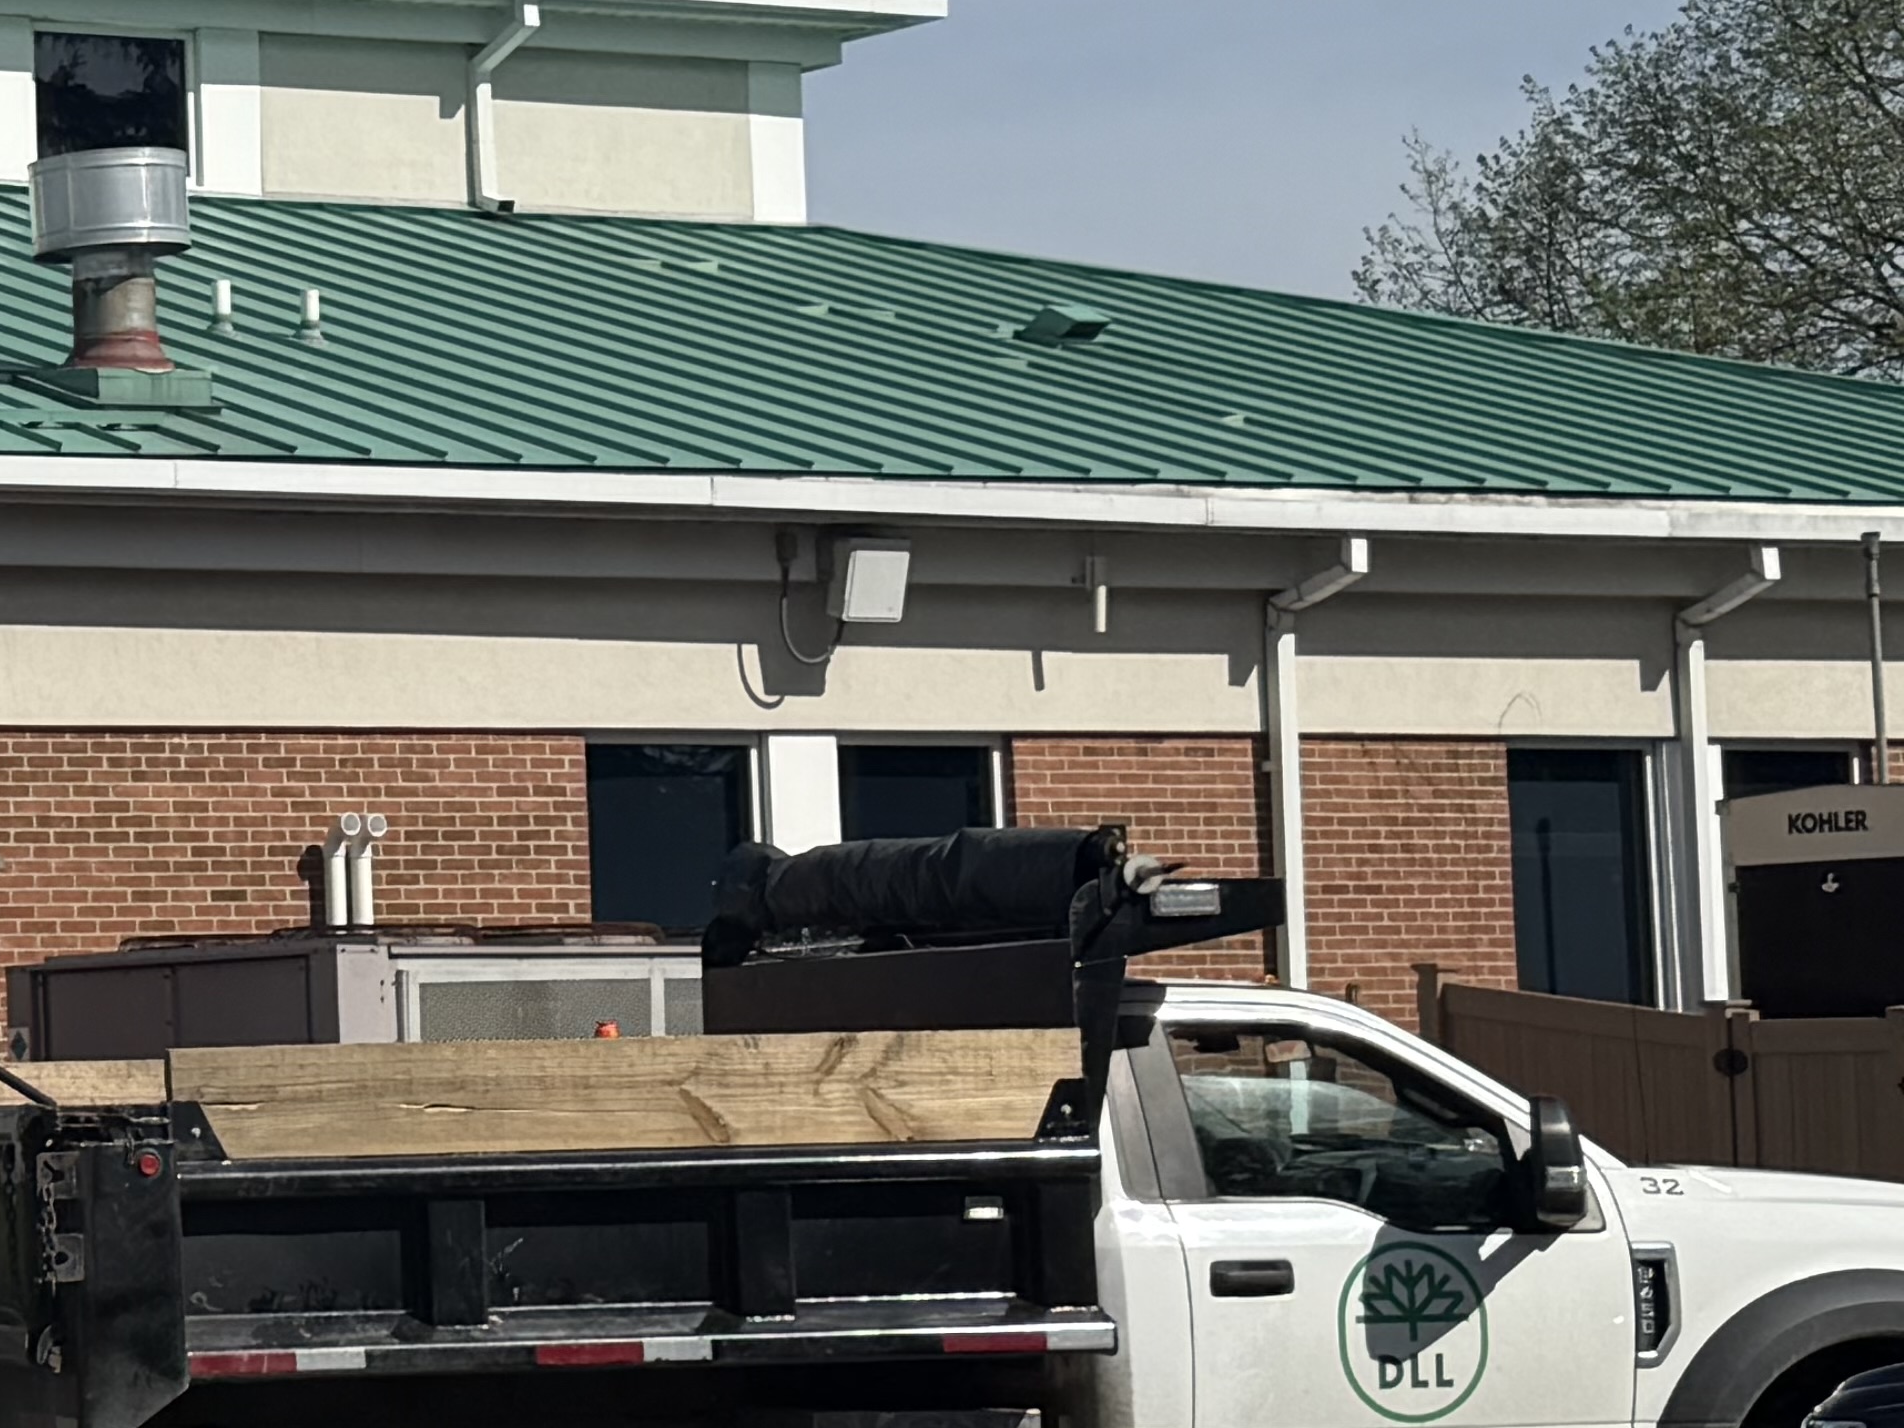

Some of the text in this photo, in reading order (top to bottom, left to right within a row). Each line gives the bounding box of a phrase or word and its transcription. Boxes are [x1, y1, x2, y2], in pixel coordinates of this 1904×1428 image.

[1787, 809, 1869, 835] KOHLER
[1639, 1176, 1685, 1196] 32
[1377, 1352, 1455, 1390] DLL
